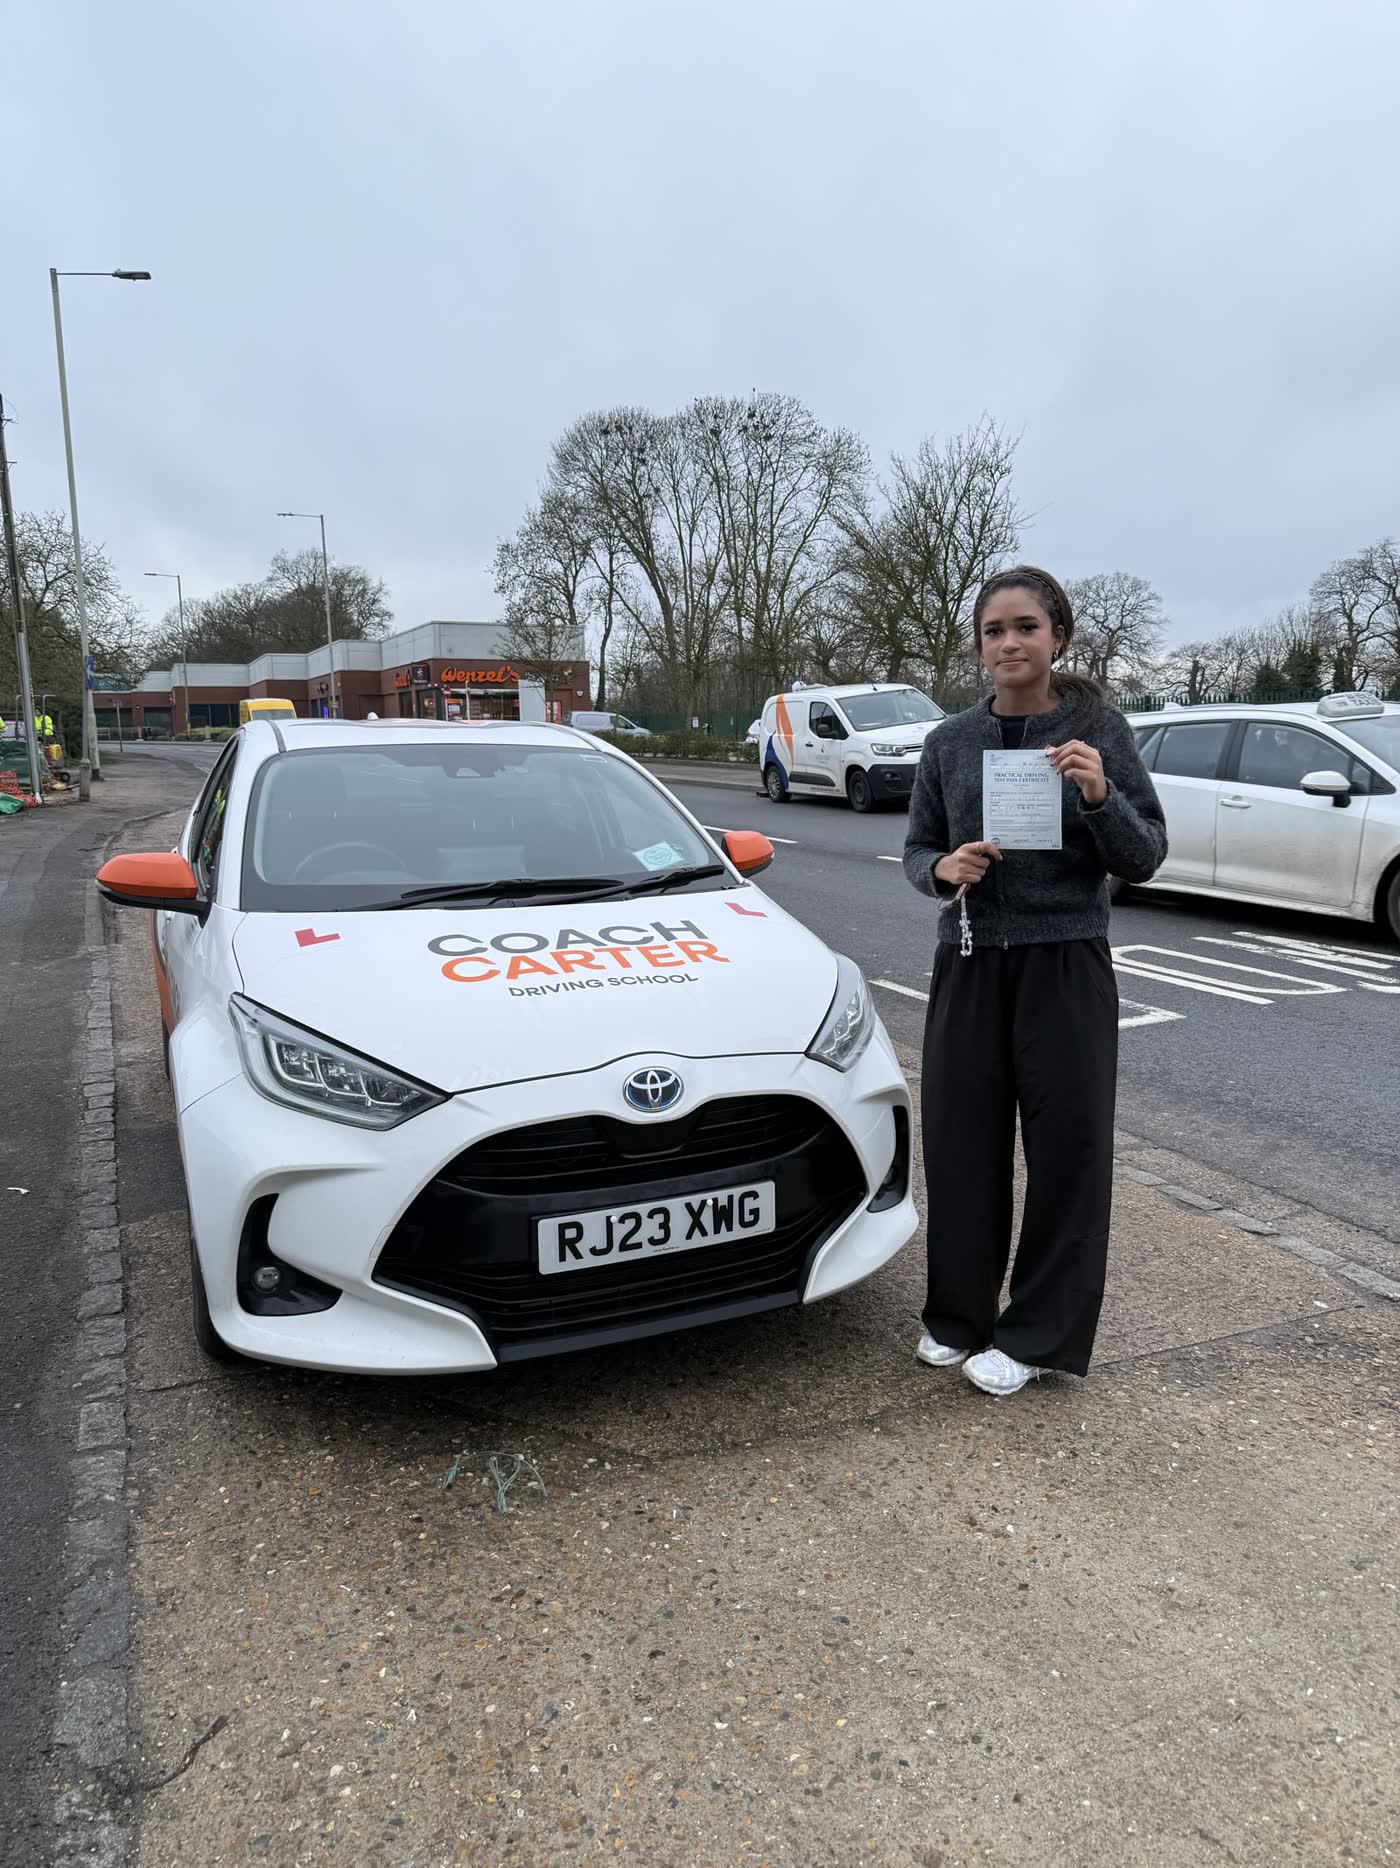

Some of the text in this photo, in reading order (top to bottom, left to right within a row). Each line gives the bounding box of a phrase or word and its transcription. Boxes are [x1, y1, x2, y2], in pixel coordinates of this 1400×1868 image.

[441, 665, 521, 683] Wenzel's
[427, 920, 709, 957] COACH
[441, 941, 731, 983] CARTER
[508, 973, 699, 997] DRIVING SCHOOL
[557, 1190, 760, 1263] RJ23 XWG
